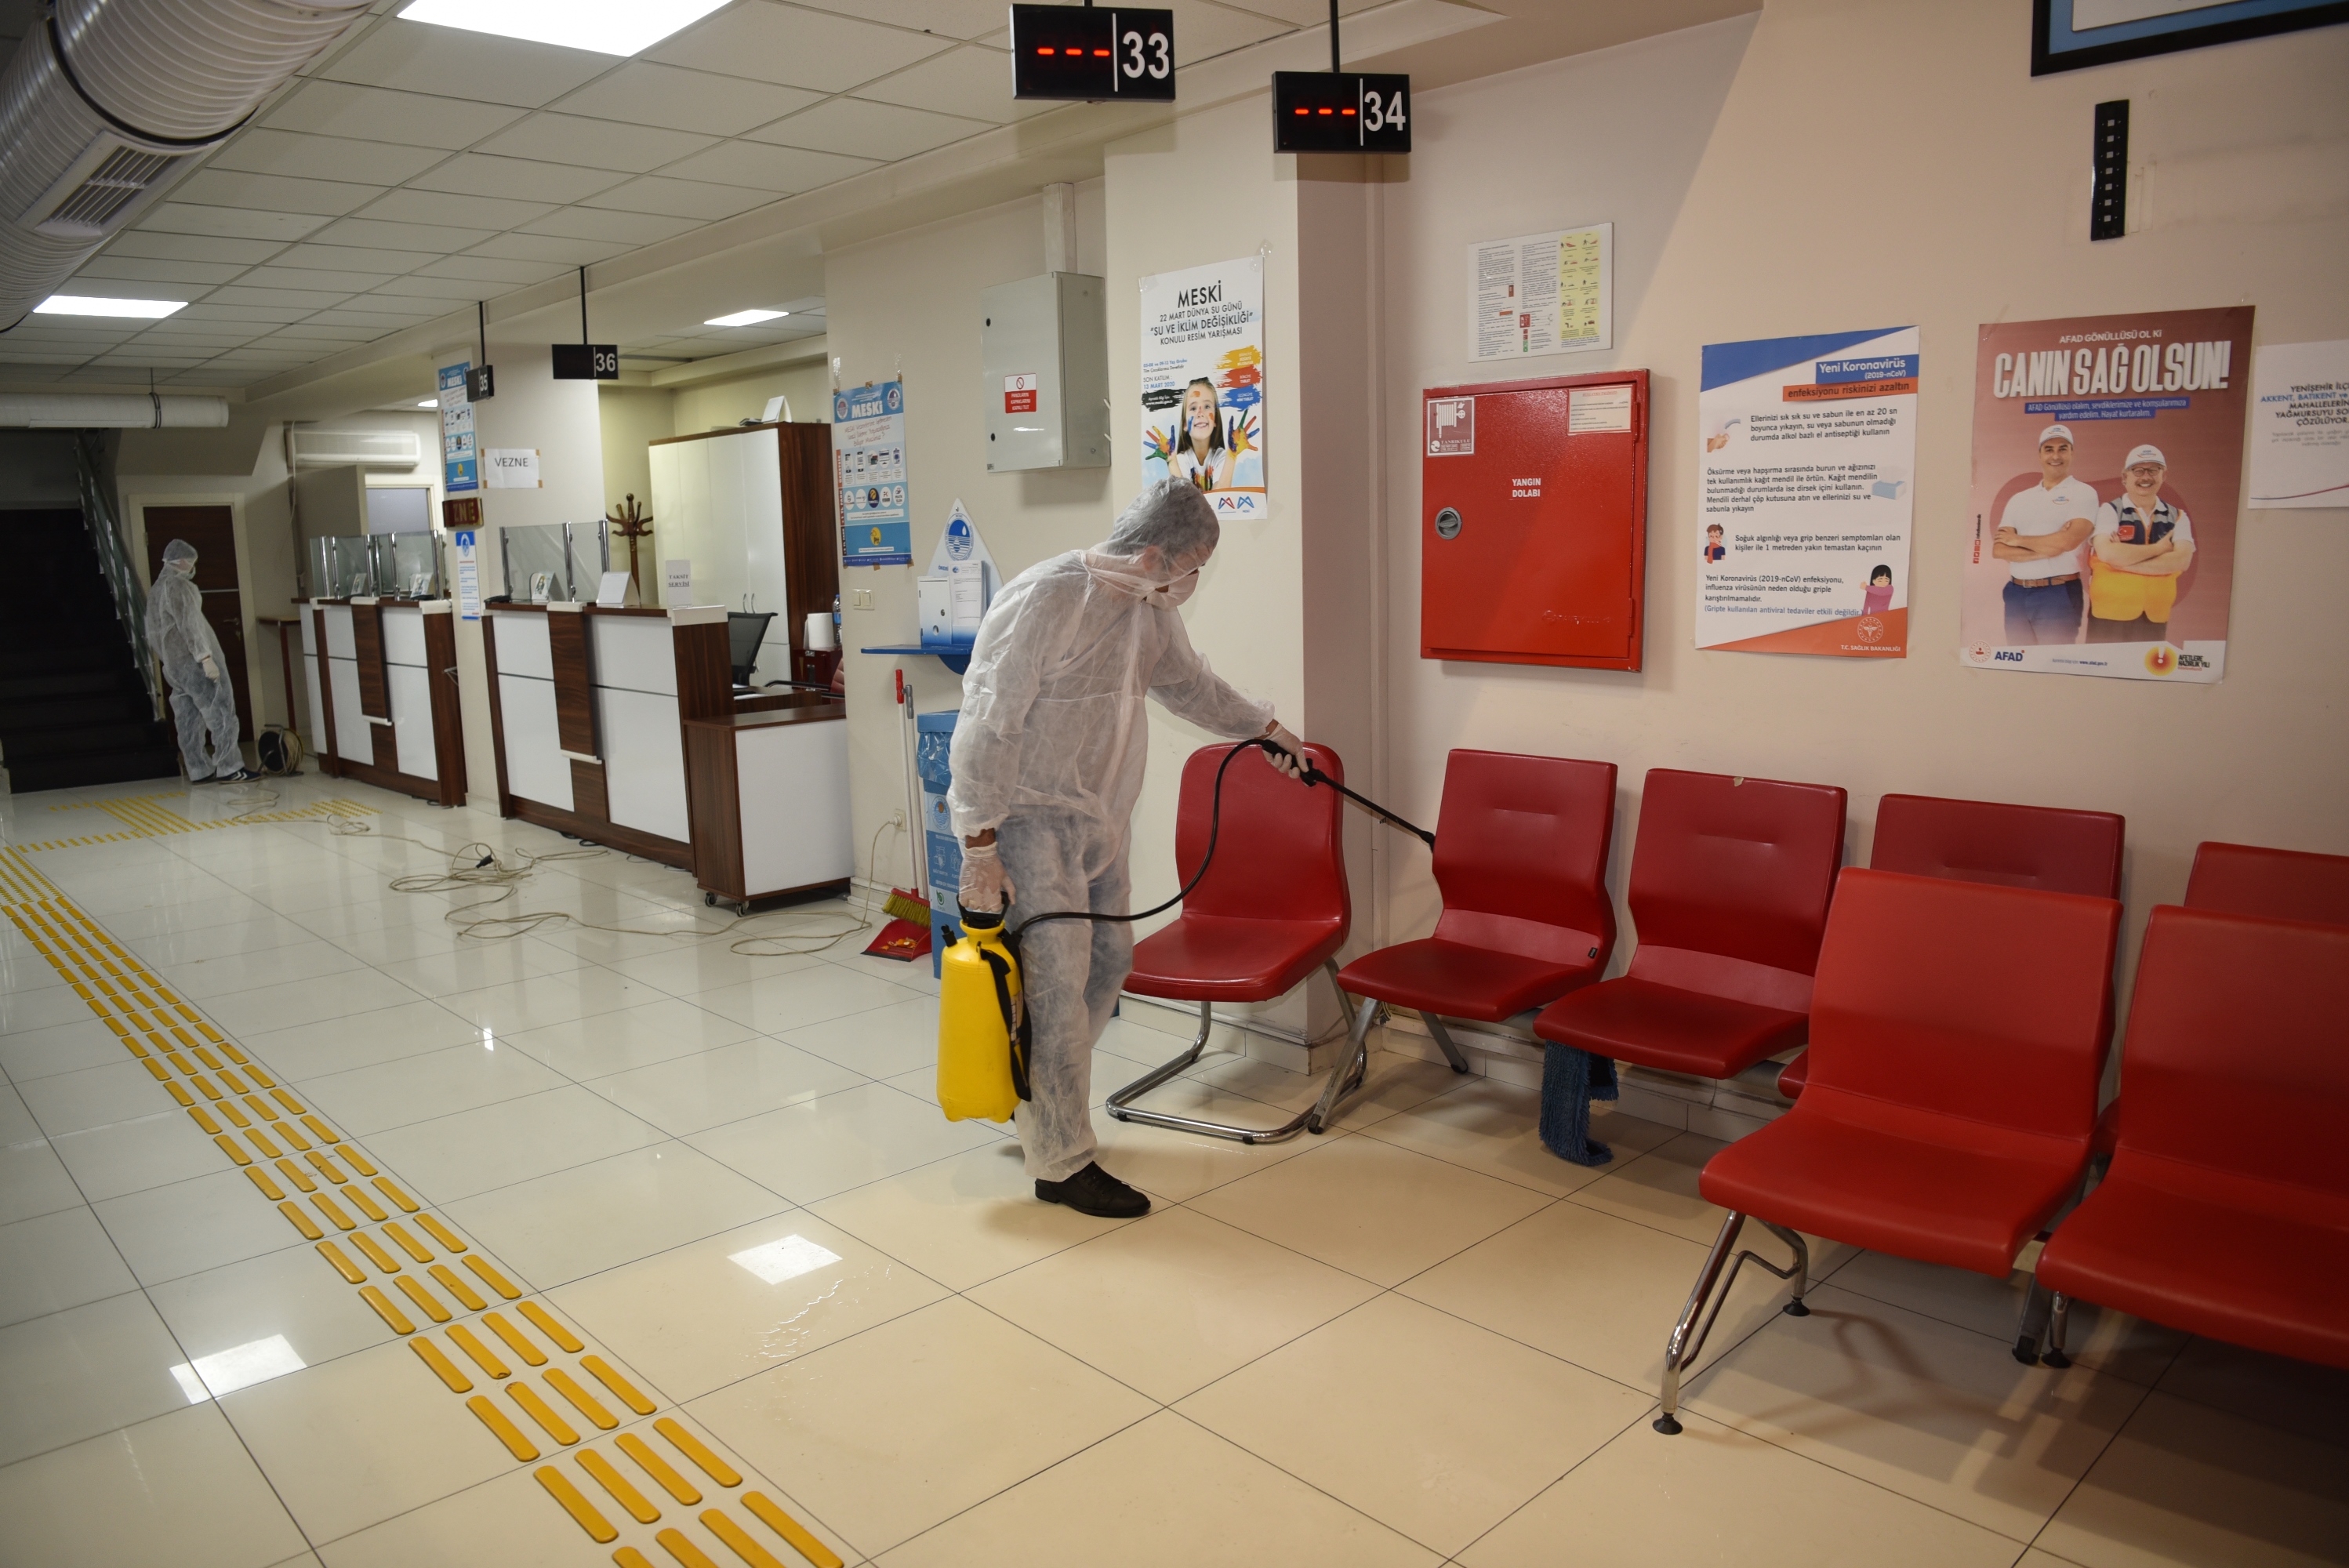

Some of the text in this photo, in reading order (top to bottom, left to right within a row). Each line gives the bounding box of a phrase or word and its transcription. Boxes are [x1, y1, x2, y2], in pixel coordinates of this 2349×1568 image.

[1122, 31, 1170, 79] 33
[1364, 91, 1406, 132] 34
[1178, 280, 1222, 308] MESKİ
[1169, 311, 1185, 321] MART
[1187, 307, 1209, 318] DÜNYA
[1222, 300, 1242, 312] GÜNÜ
[1166, 324, 1175, 334] VE
[1178, 319, 1198, 332] İKLİM
[1160, 327, 1242, 345] KONULU RESİM YARIŞMASI
[2060, 334, 2083, 343] AFAD
[2085, 330, 2137, 342] GÖNÜLLÜSÜ
[596, 354, 616, 372] 36
[1819, 359, 1905, 373] Yeni Koronavirüs
[1864, 370, 1906, 379] (2019-nCoV)
[1993, 340, 2231, 398] CANIN SAĞ OLSUN!
[480, 374, 488, 391] 35
[2290, 382, 2349, 392] YENİŞEHİR İLÇ
[1788, 382, 1909, 397] enfeksiyonu riskinizi azaltın
[2260, 394, 2295, 402] AKKENT,
[2298, 392, 2336, 401] BATIKENT
[2091, 401, 2133, 409] sevdiklerimize
[2289, 399, 2349, 409] MAHALLELERİN
[2059, 411, 2079, 420] yardım
[2101, 410, 2118, 419] Hayat
[2275, 408, 2333, 419] YAĞMURSUYU
[1751, 425, 1777, 434] boyunca
[1780, 423, 1805, 432] yıkayın,
[1824, 430, 1860, 439] antiseptiği
[495, 457, 528, 467] VEZNE
[1753, 466, 1782, 475] hapşırma
[1512, 477, 1541, 487] YANGIN
[1512, 488, 1541, 498] DOLABI
[1994, 651, 2023, 662] AFAD
